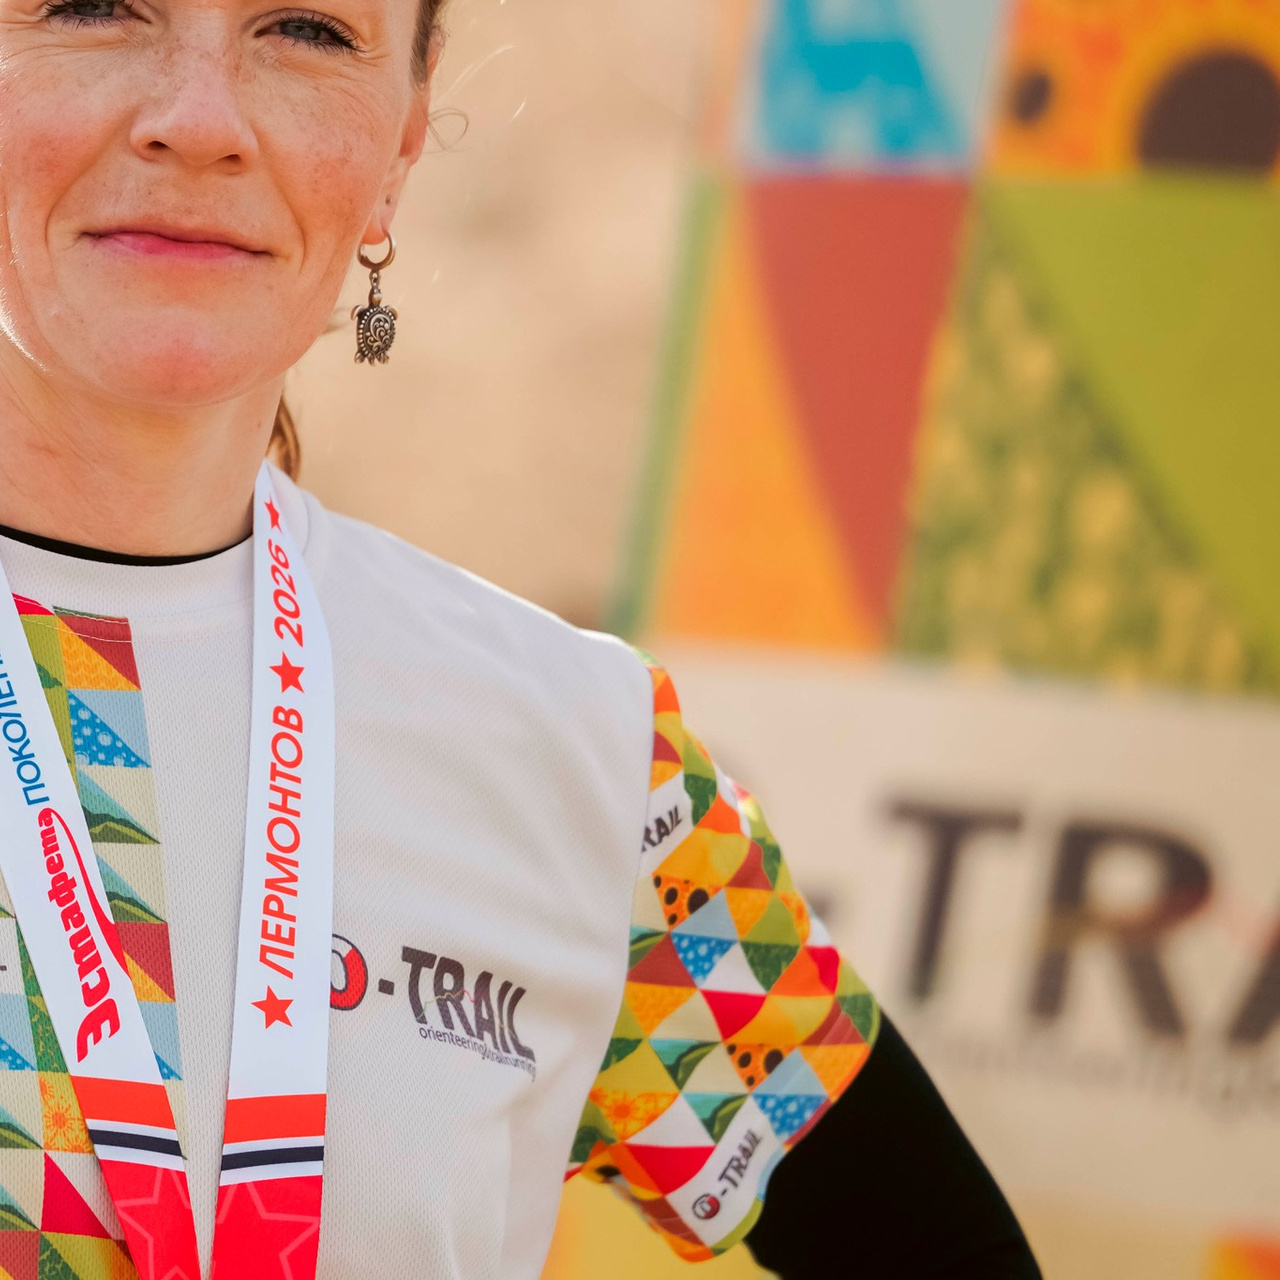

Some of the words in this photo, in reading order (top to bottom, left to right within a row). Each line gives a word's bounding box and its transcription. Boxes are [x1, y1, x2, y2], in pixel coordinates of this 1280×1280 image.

[267, 540, 304, 648] 2026
[259, 705, 304, 979] ЛЕРМОНТОВ
[692, 1128, 762, 1220] O-TRAIL
